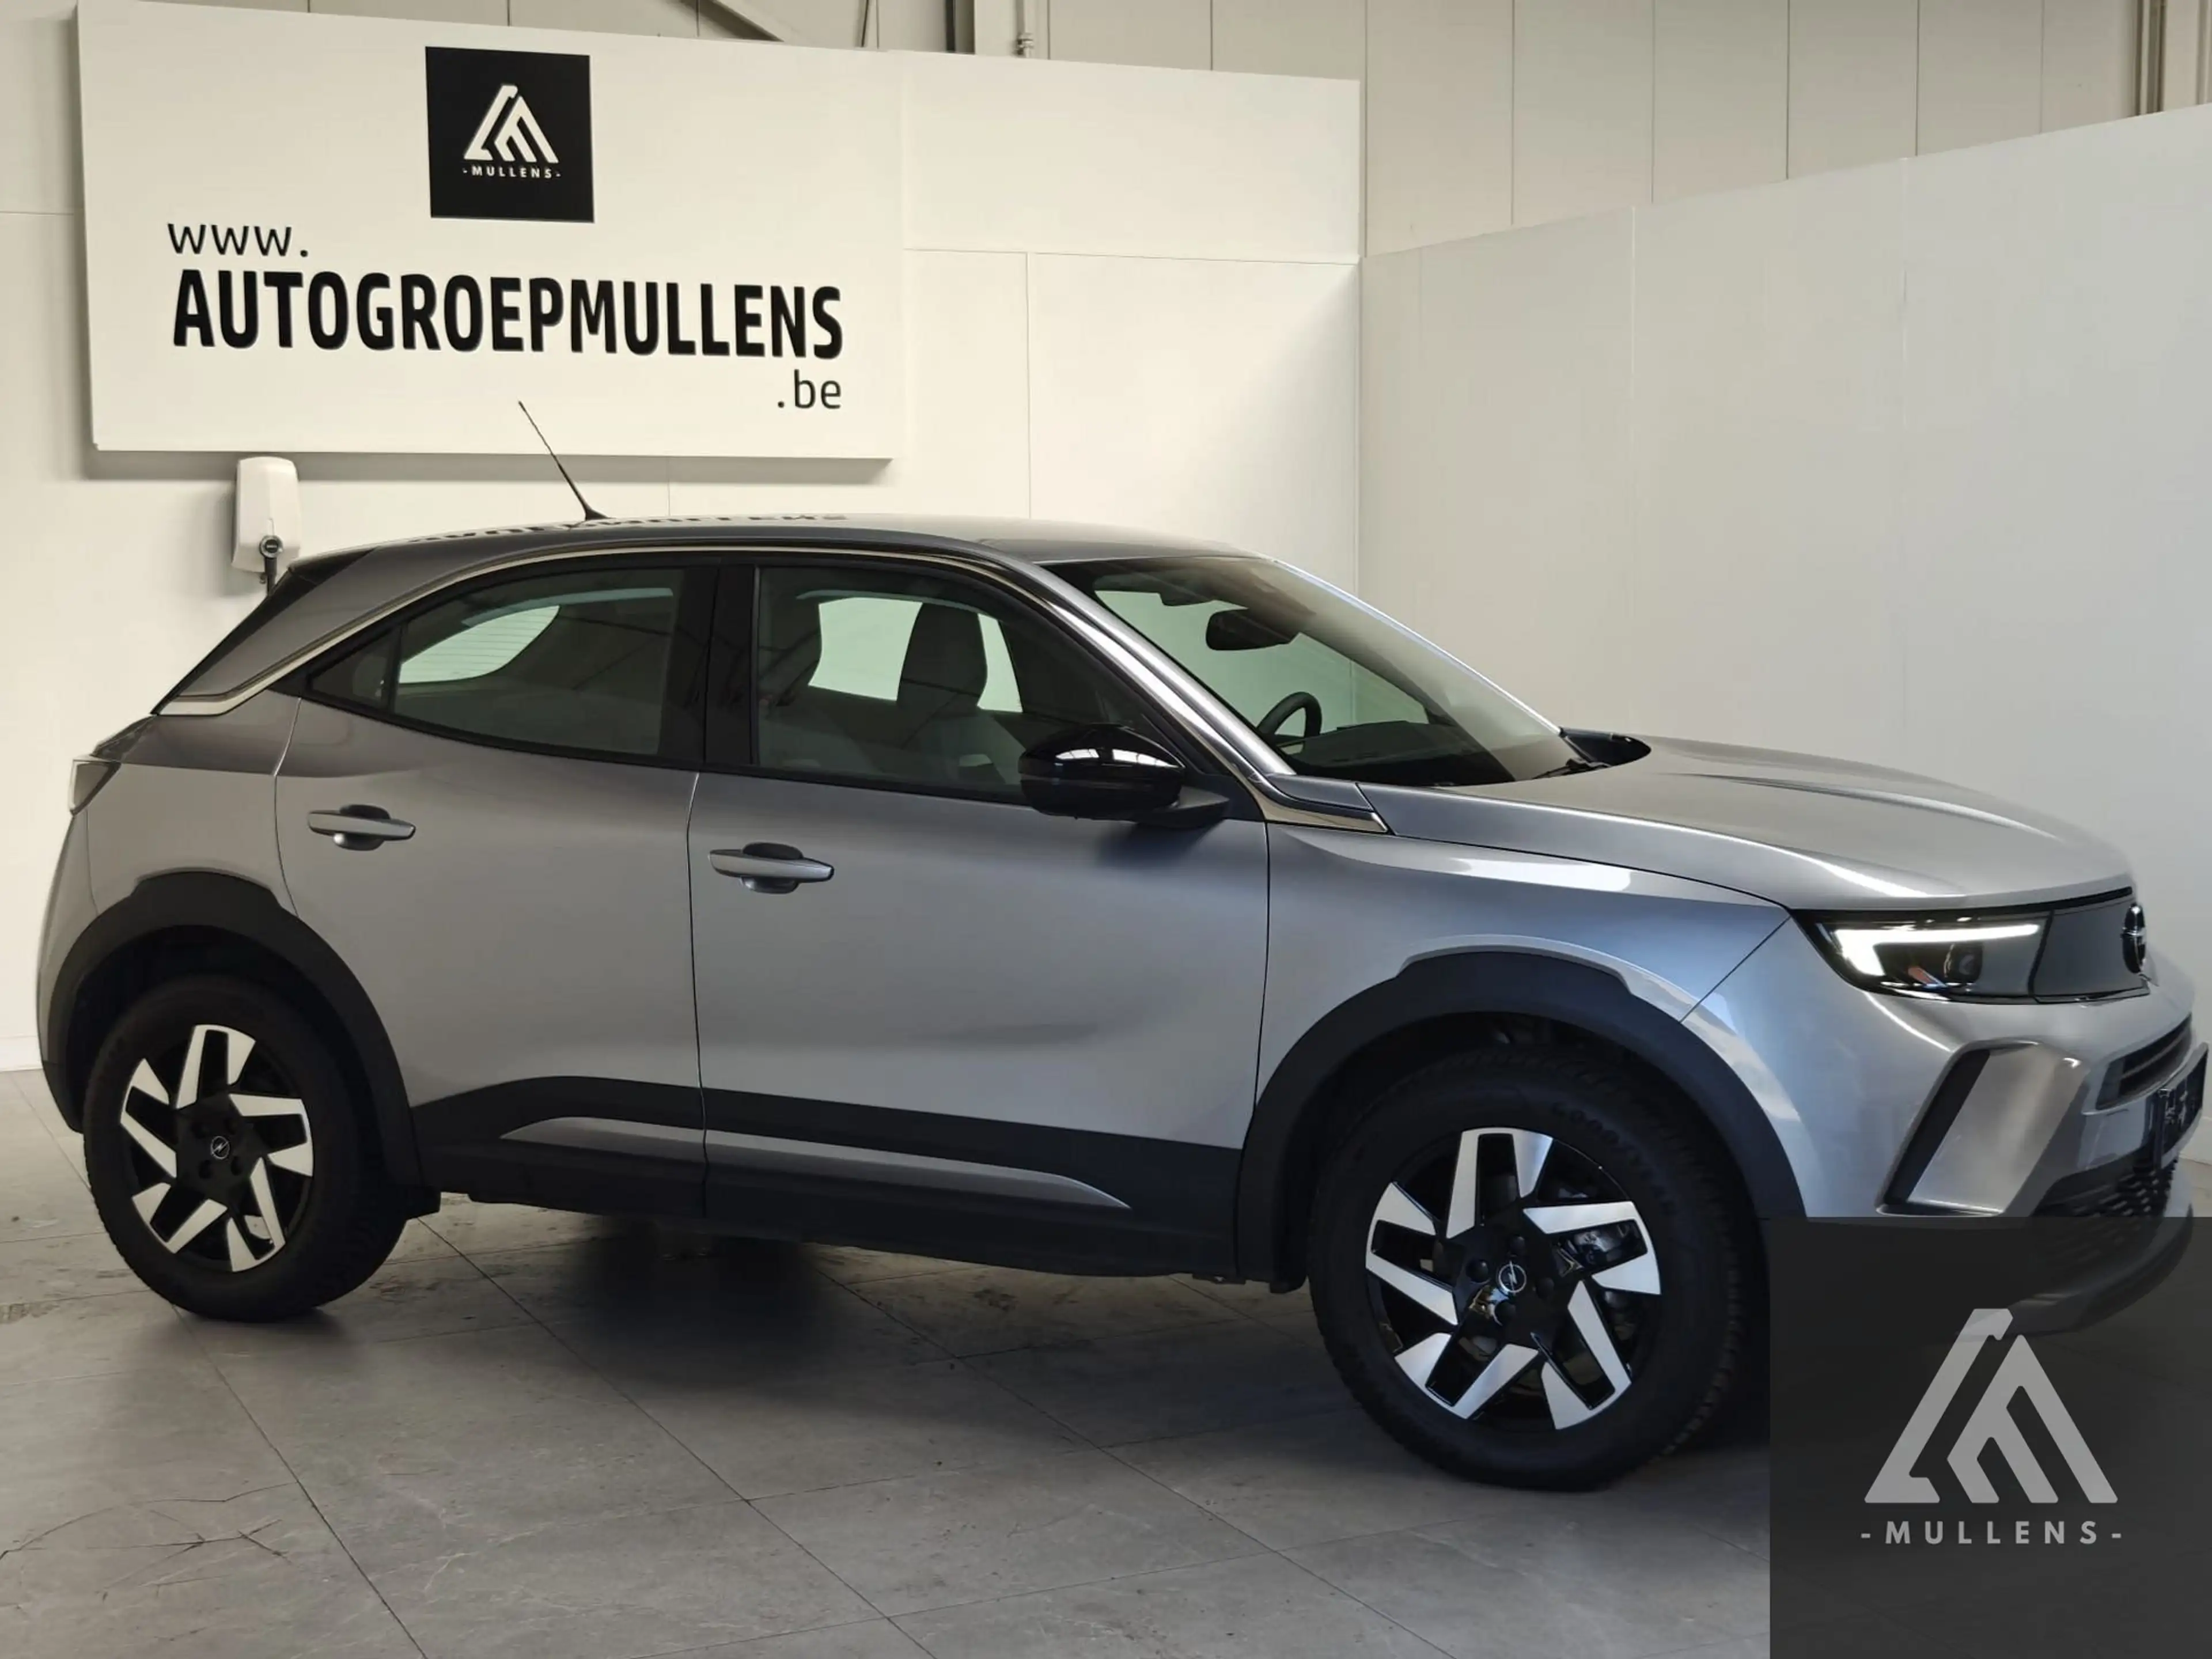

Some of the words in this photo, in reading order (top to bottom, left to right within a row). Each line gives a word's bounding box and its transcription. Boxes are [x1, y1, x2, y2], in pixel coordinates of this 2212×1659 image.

[167, 222, 309, 257] www.
[173, 269, 842, 359] AUTOGROEPMULLENS
[777, 369, 842, 410] .be
